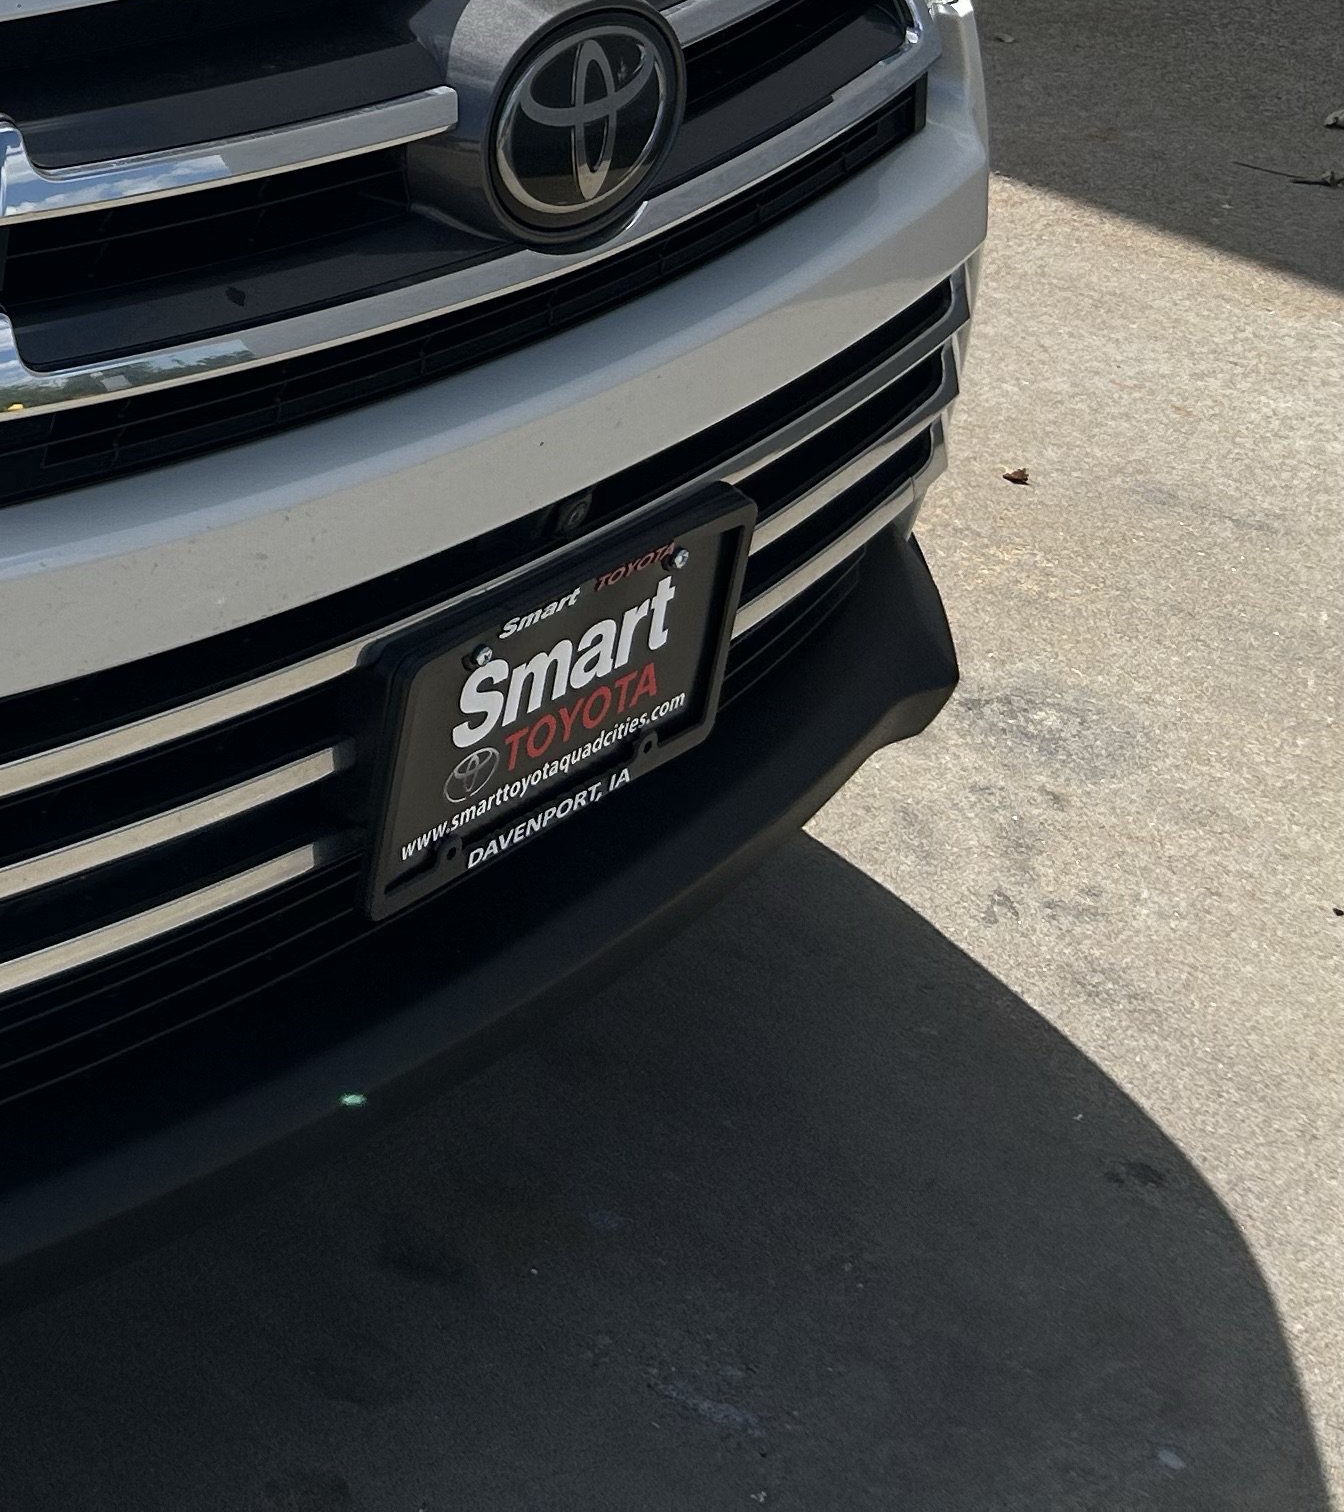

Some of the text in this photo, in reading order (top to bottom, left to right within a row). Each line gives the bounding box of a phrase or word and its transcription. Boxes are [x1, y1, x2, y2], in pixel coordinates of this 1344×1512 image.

[499, 541, 676, 640] Smart TOYOTA
[452, 575, 676, 748] Smart
[503, 662, 658, 771] TOYOTA
[400, 691, 686, 862] www.smarttoyotaquadcities.com
[466, 766, 631, 870] DAVENPORT, IA
